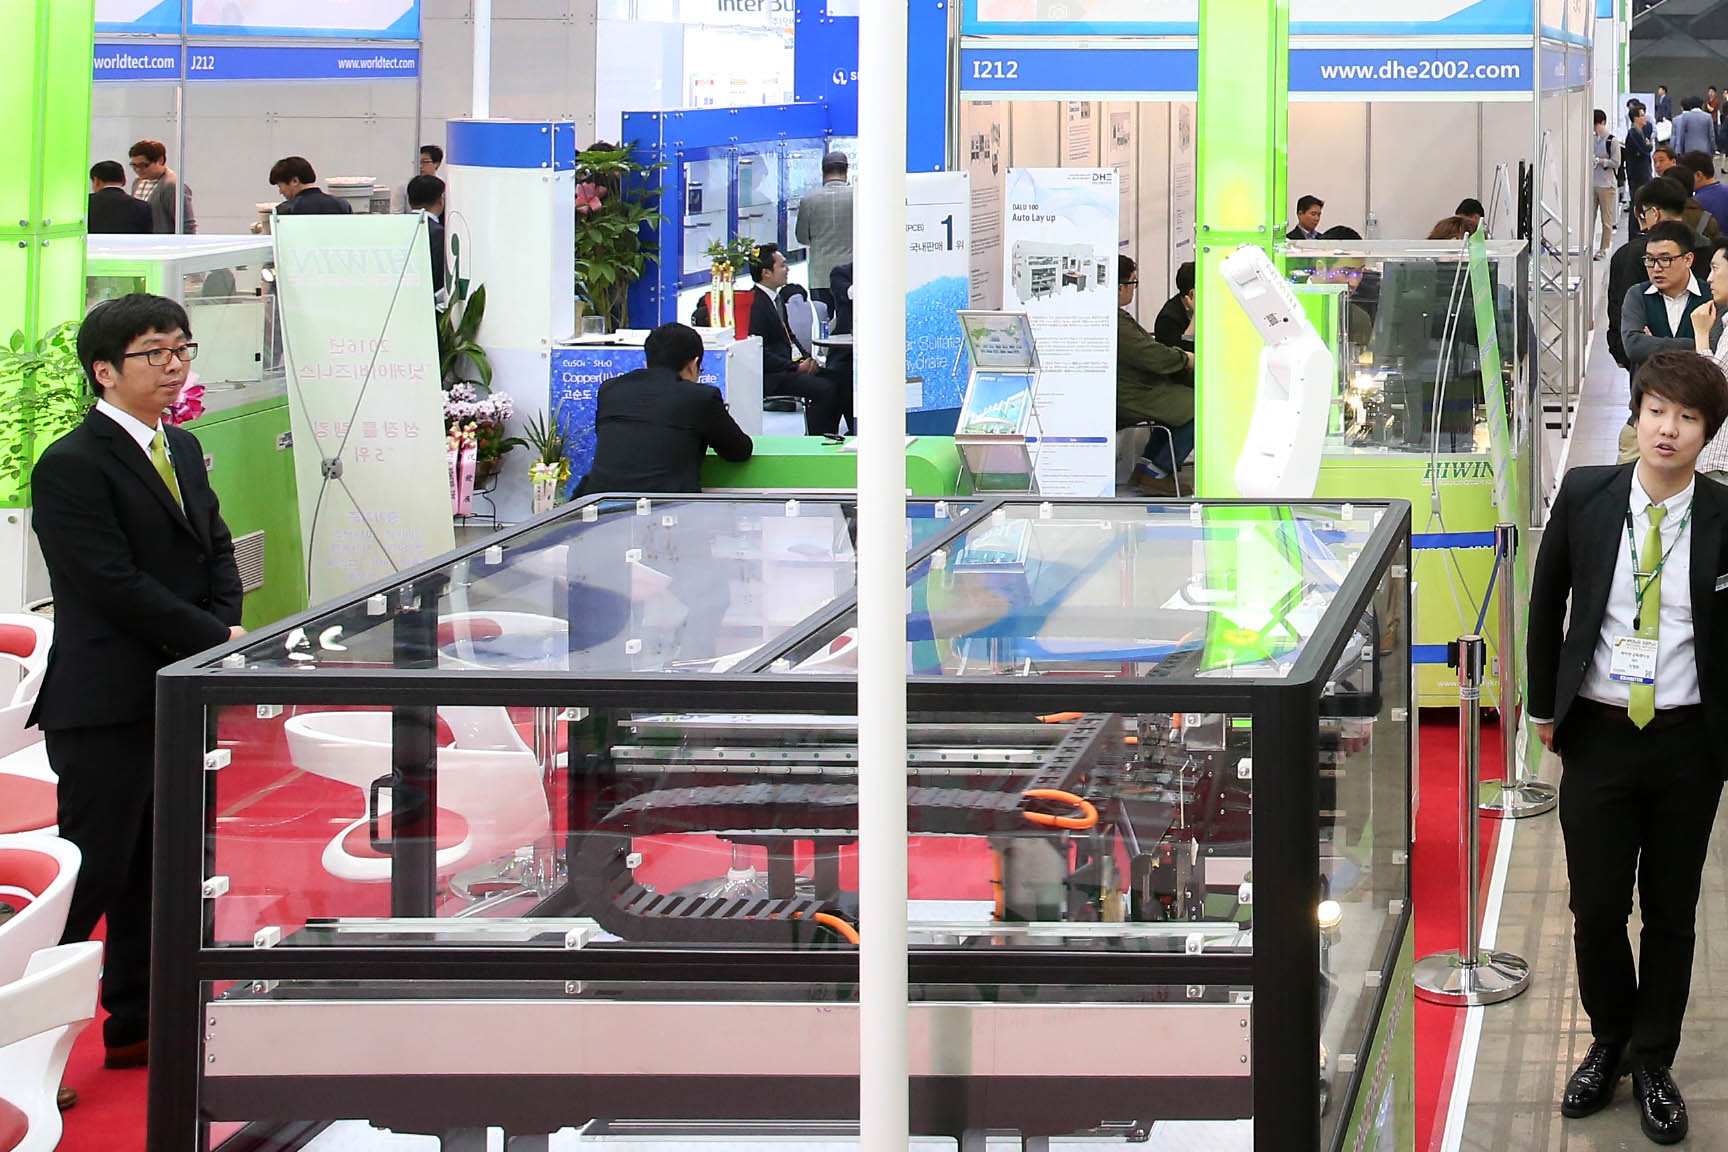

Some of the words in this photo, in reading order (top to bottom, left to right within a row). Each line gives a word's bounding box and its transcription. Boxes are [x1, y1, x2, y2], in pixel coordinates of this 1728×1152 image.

[190, 55, 215, 71] J212
[338, 57, 415, 71] www.worldtect.com
[973, 61, 1018, 79] I212
[1320, 59, 1521, 85] www.dhe2002.com
[1012, 213, 1030, 222] Auto
[1032, 213, 1045, 224] Lay
[941, 214, 953, 251] 1
[1424, 462, 1495, 479] HIWIN
